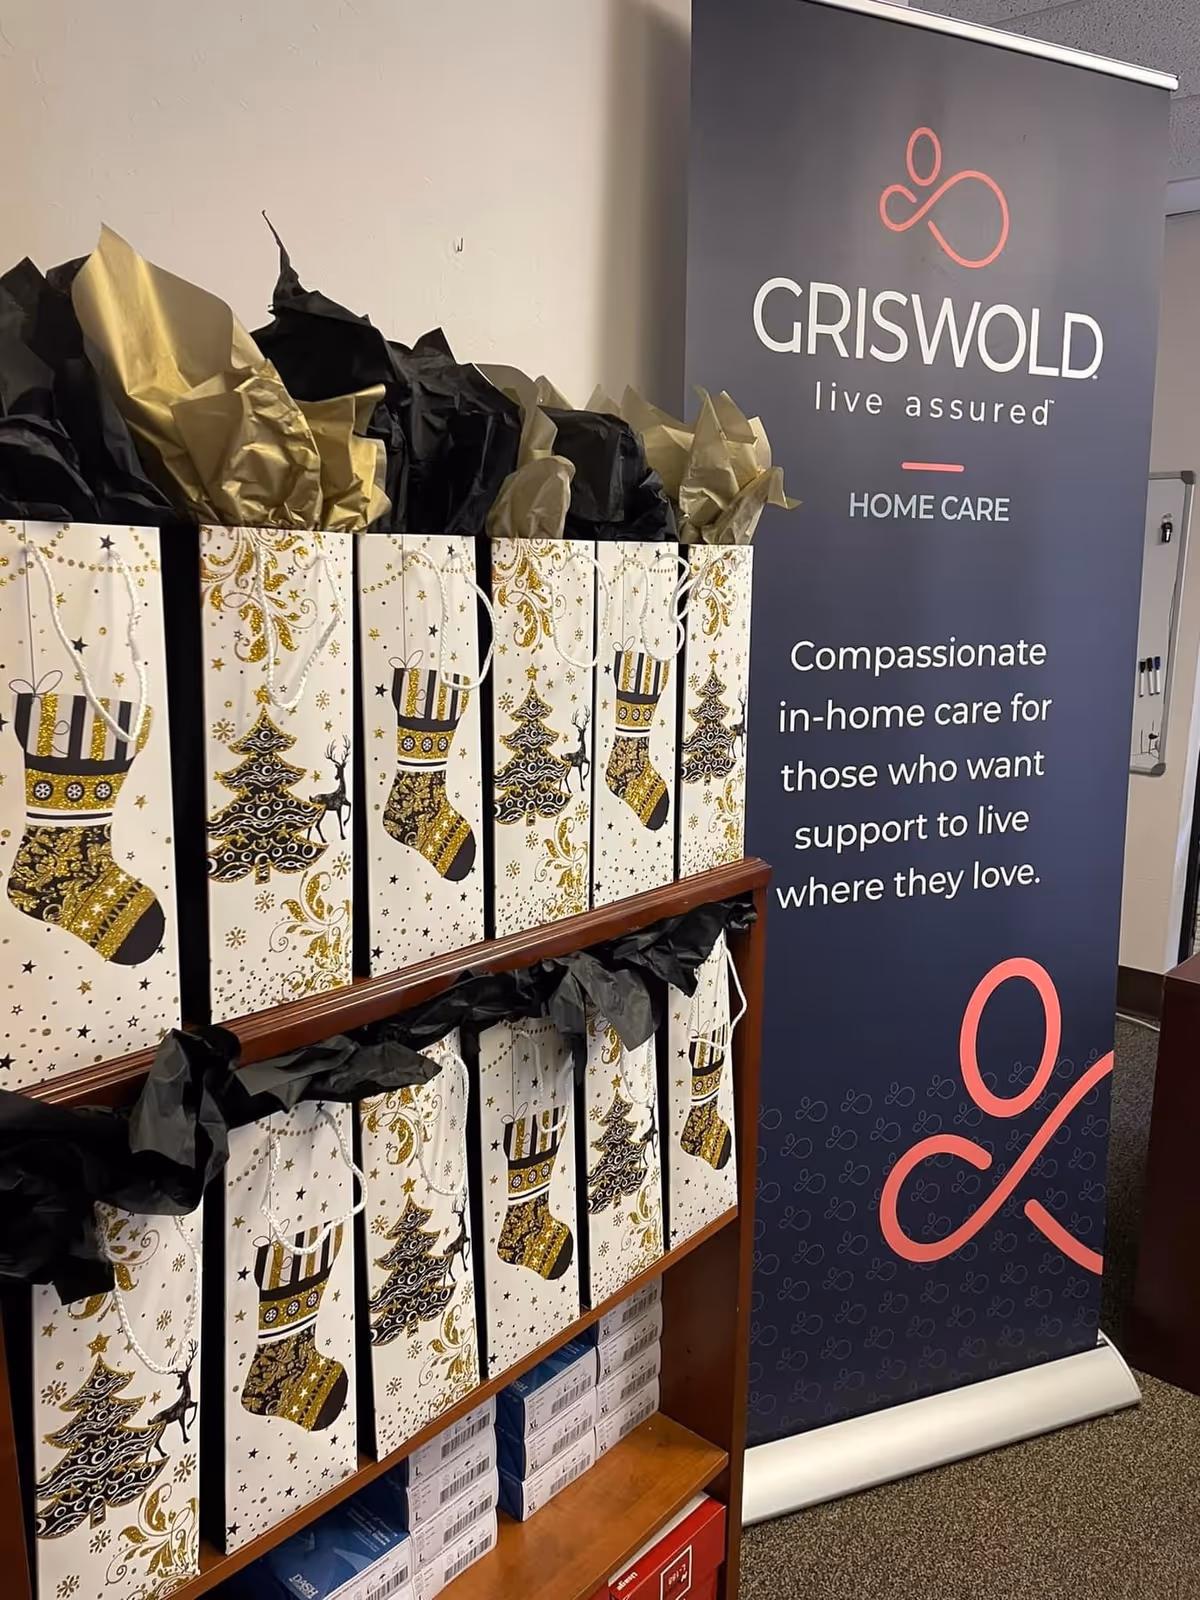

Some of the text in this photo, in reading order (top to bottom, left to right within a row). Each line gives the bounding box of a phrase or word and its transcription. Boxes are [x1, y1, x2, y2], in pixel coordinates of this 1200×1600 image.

[752, 277, 1104, 380] GRISWOLD
[815, 380, 883, 415] live
[849, 492, 1010, 522] HOME CARE
[790, 636, 1047, 677] Compassionate
[779, 692, 1053, 733] in-home care for
[780, 750, 1046, 793] those who want
[794, 804, 1030, 854] support to live
[776, 860, 1042, 910] where they love.
[291, 1573, 319, 1598] DASH
